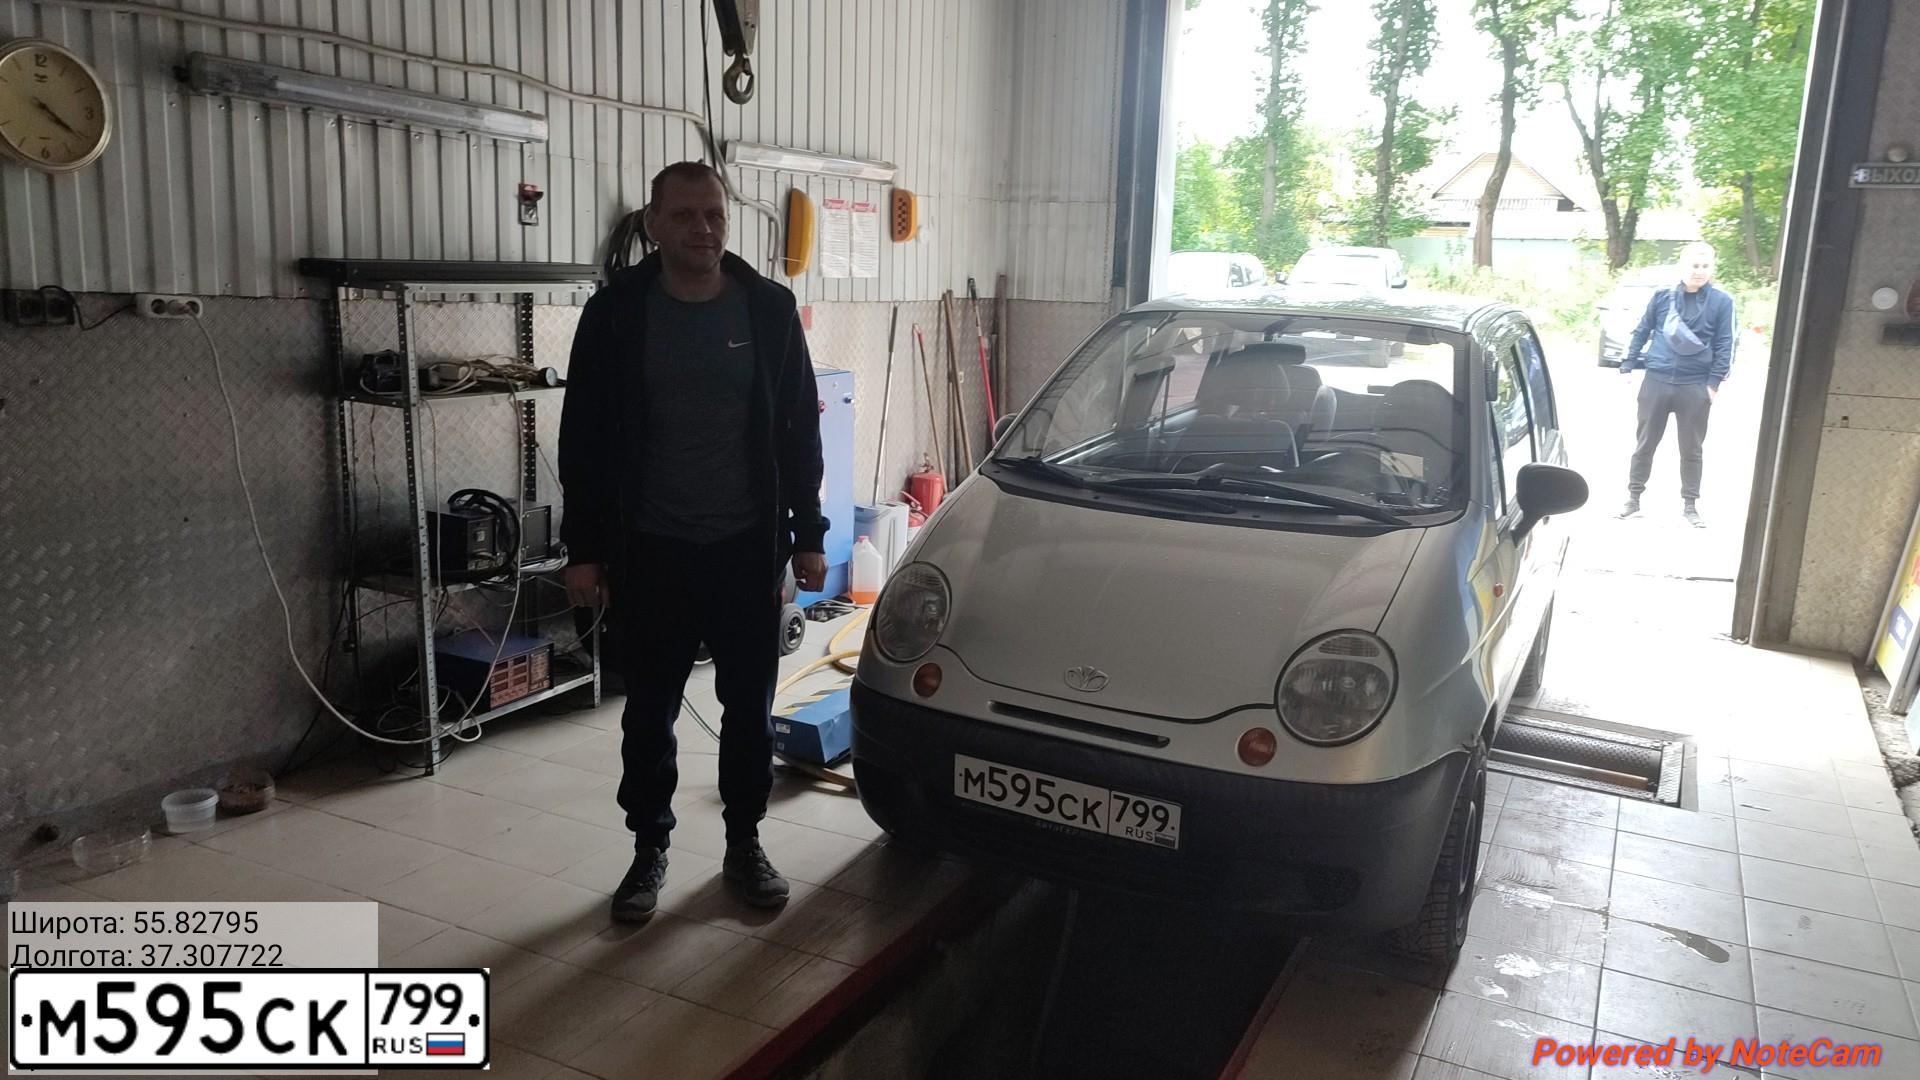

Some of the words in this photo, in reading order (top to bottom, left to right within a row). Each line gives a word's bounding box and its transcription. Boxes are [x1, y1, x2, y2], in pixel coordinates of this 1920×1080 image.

[35, 53, 48, 67] 12
[85, 106, 94, 120] 3
[41, 147, 50, 159] 6
[1112, 794, 1170, 833] 799
[1125, 826, 1153, 842] RUS
